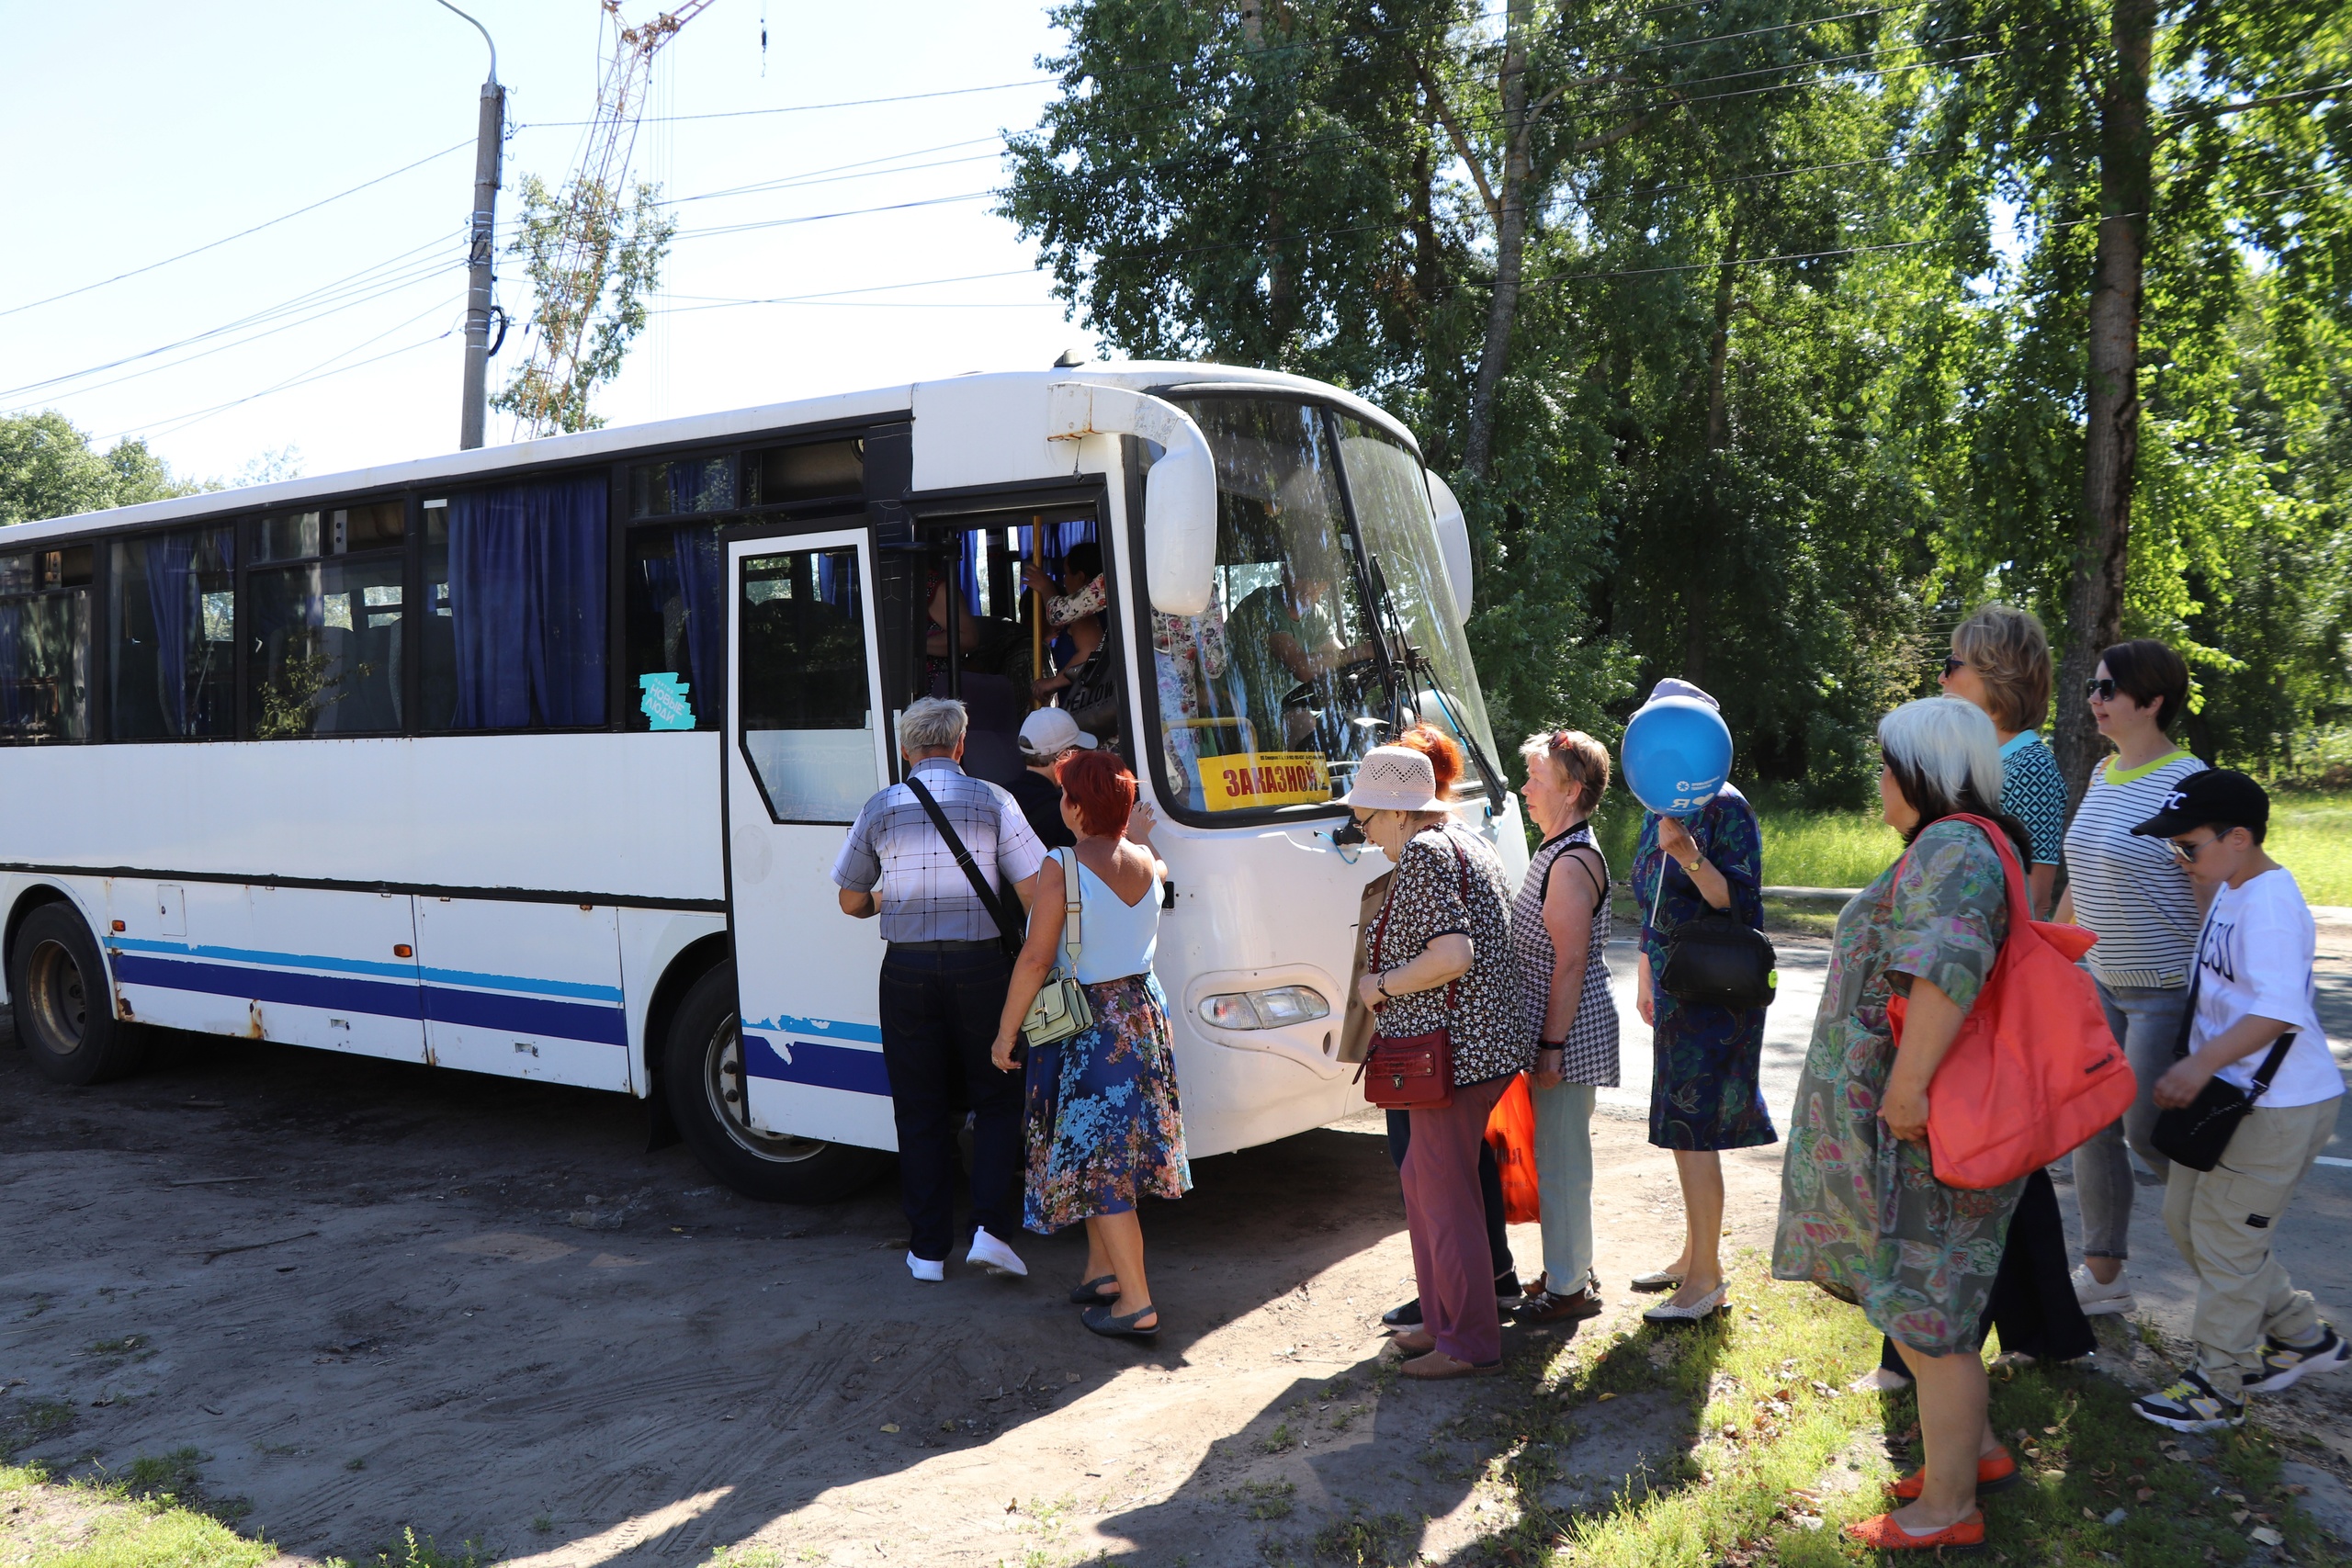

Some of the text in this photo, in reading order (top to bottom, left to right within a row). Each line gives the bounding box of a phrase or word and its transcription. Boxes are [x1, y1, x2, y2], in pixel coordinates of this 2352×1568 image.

[645, 697, 675, 724] ЛЮДИ
[650, 683, 684, 716] НОВЫЕ
[1223, 761, 1317, 797] ЗАКАЗНОЙ
[1670, 798, 1690, 808] Я
